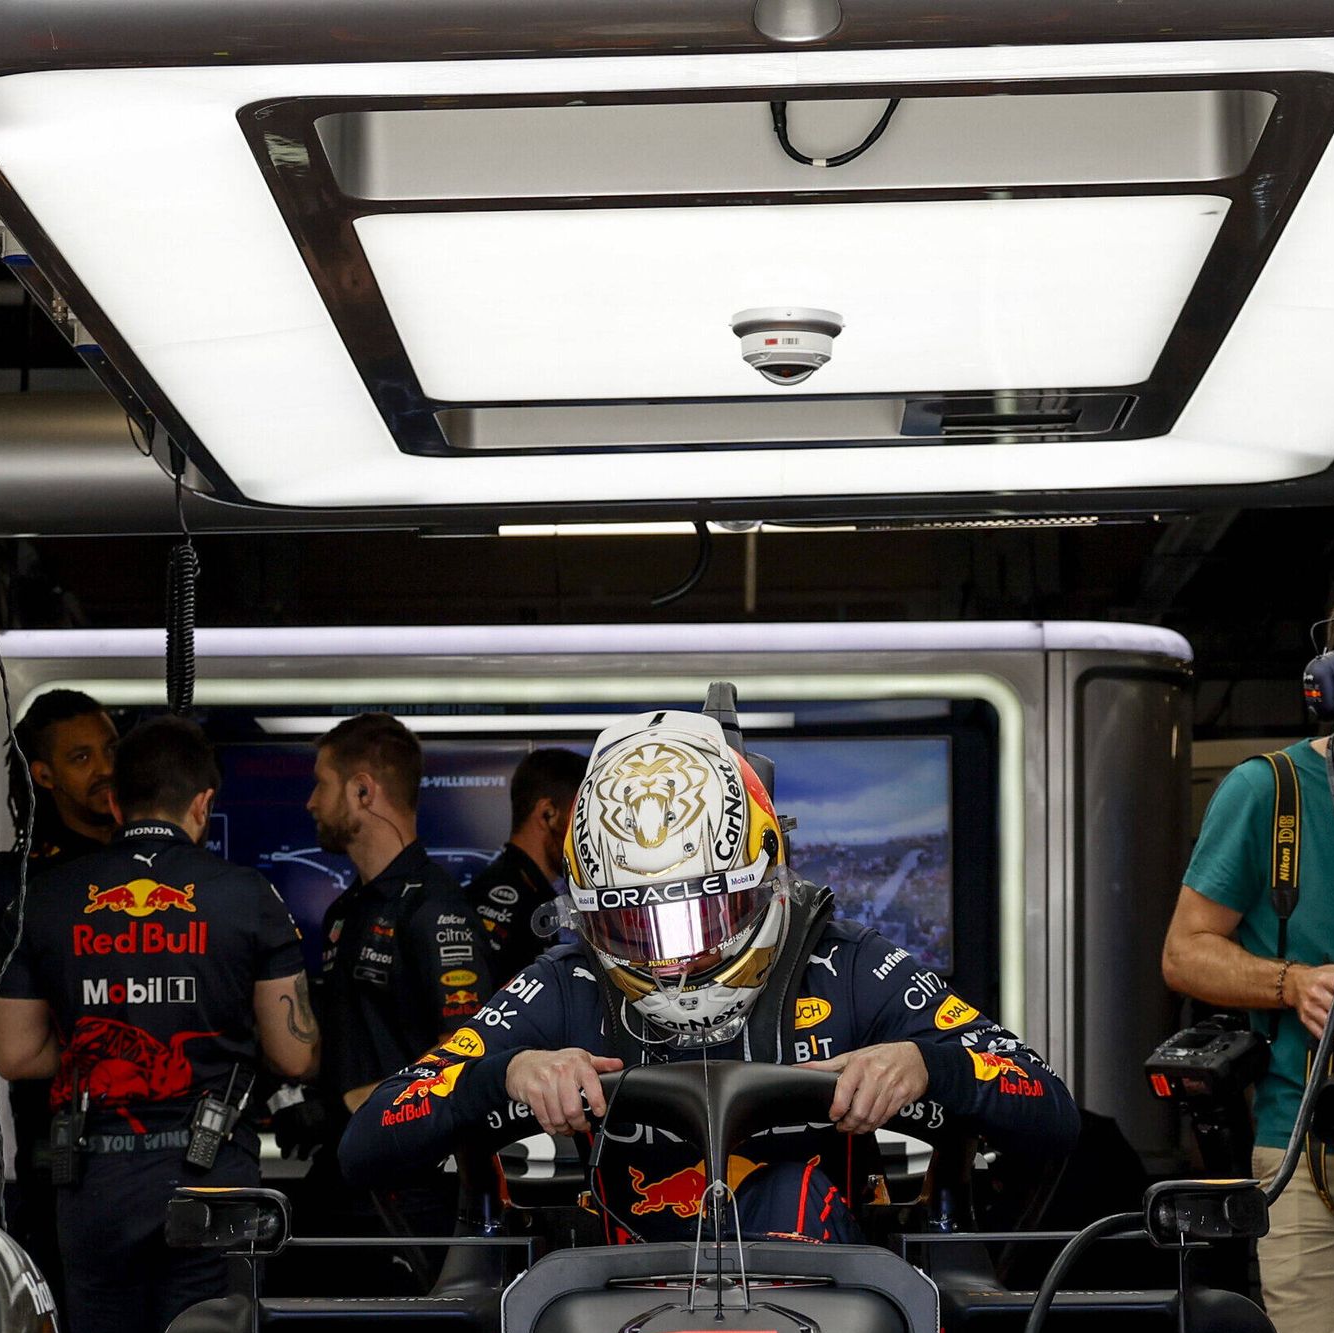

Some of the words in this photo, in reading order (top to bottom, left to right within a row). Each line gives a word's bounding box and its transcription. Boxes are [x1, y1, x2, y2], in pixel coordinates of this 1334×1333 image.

[714, 763, 743, 861] CarNext
[124, 827, 175, 838] HONDA
[574, 779, 601, 879] CarNext
[731, 875, 748, 885] Mobil
[1279, 848, 1291, 881] Nikon
[601, 876, 722, 908] ORACLE
[73, 921, 138, 956] Red
[142, 921, 208, 954] Bull
[872, 947, 911, 981] infinit
[83, 977, 163, 1005] Mobil
[647, 1000, 745, 1032] CarNext
[947, 1000, 970, 1020] RAU
[1000, 1076, 1024, 1096] Red
[1023, 1079, 1045, 1097] Bull
[381, 1105, 406, 1126] Red
[405, 1095, 433, 1121] Bull
[103, 1135, 135, 1151] YOU
